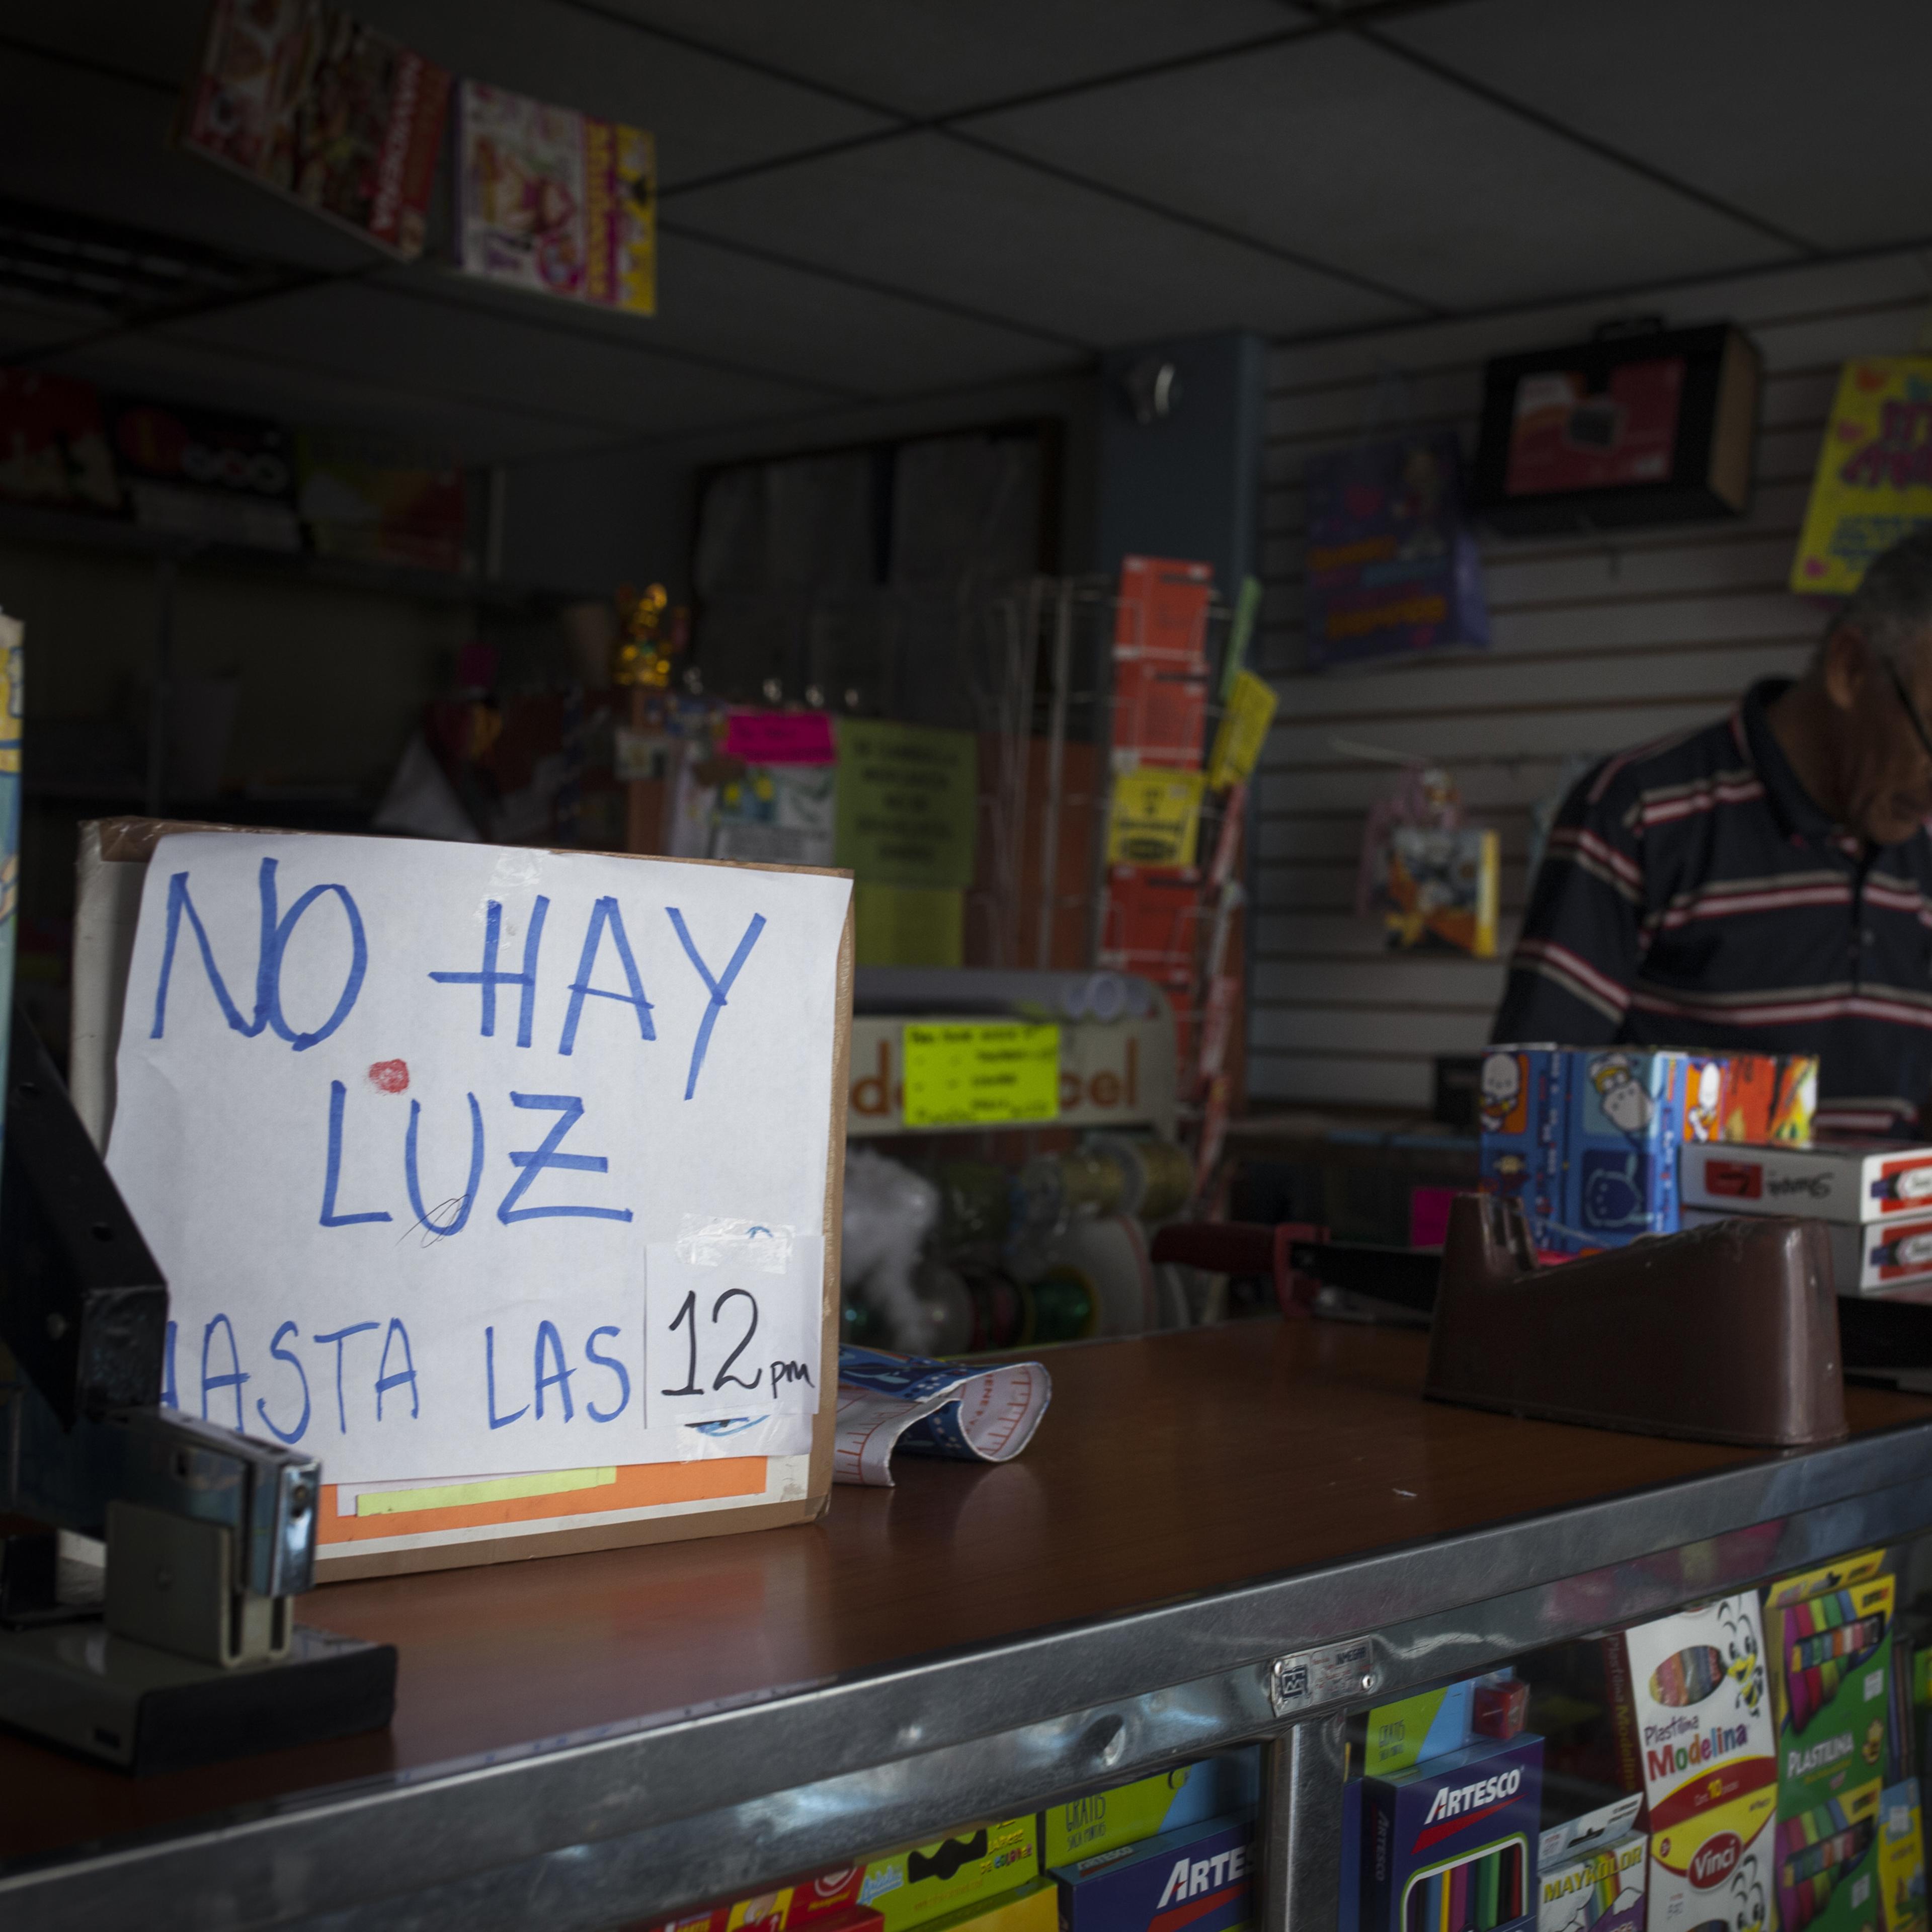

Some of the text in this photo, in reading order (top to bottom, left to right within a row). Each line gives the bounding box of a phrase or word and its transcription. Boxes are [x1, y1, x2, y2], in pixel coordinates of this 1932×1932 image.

[149, 857, 368, 1053] NO
[428, 895, 767, 1100] HAY
[318, 1079, 634, 1237] LUZ
[486, 1320, 631, 1431] LAS
[1647, 1723, 1748, 1782] Modelina
[1787, 1731, 1854, 1780] PLASTILINA
[1424, 1768, 1521, 1825] ARTESCO
[1543, 1845, 1643, 1904] MAYKOLOR
[1695, 1839, 1736, 1881] Vinci
